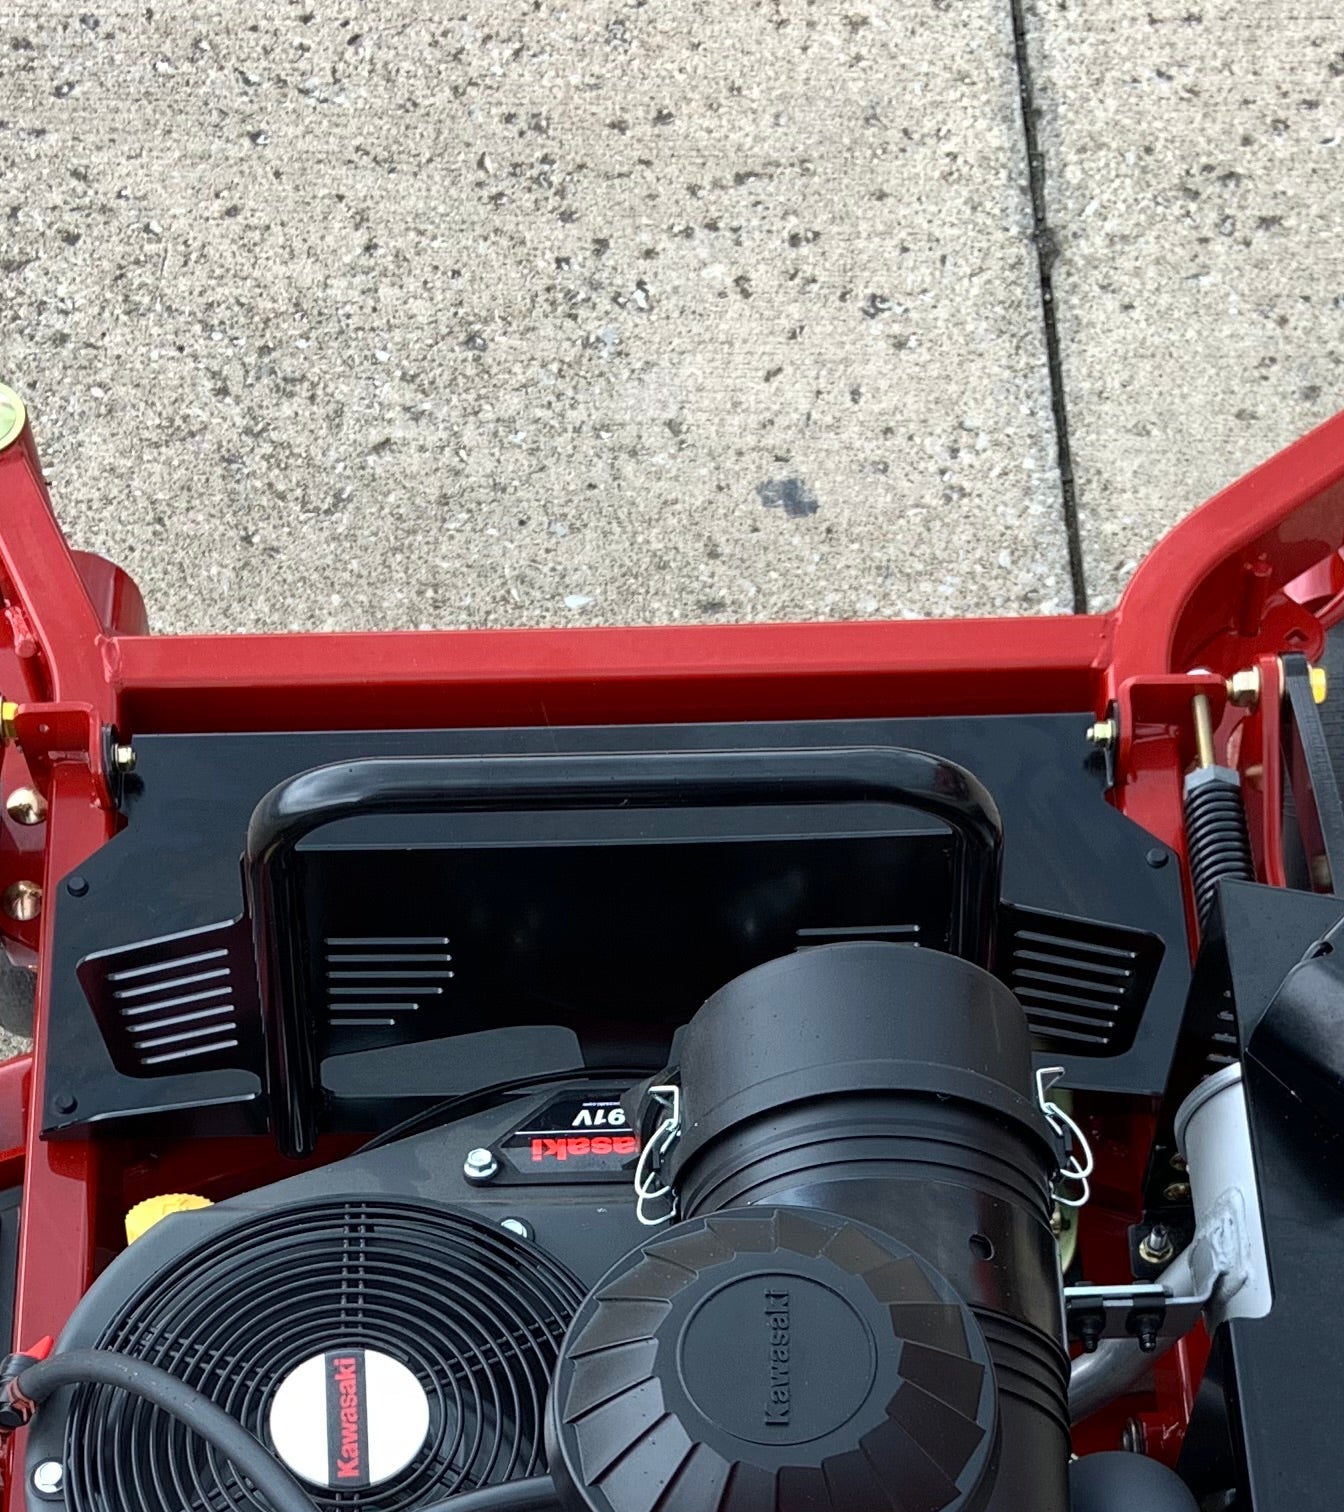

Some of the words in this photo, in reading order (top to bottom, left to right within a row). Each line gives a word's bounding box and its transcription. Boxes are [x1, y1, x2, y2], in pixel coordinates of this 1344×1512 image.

[532, 1137, 636, 1161] asaki
[572, 1108, 626, 1127] 91V
[764, 1287, 790, 1427] Kawasaki
[332, 1356, 361, 1479] Kawasaki
